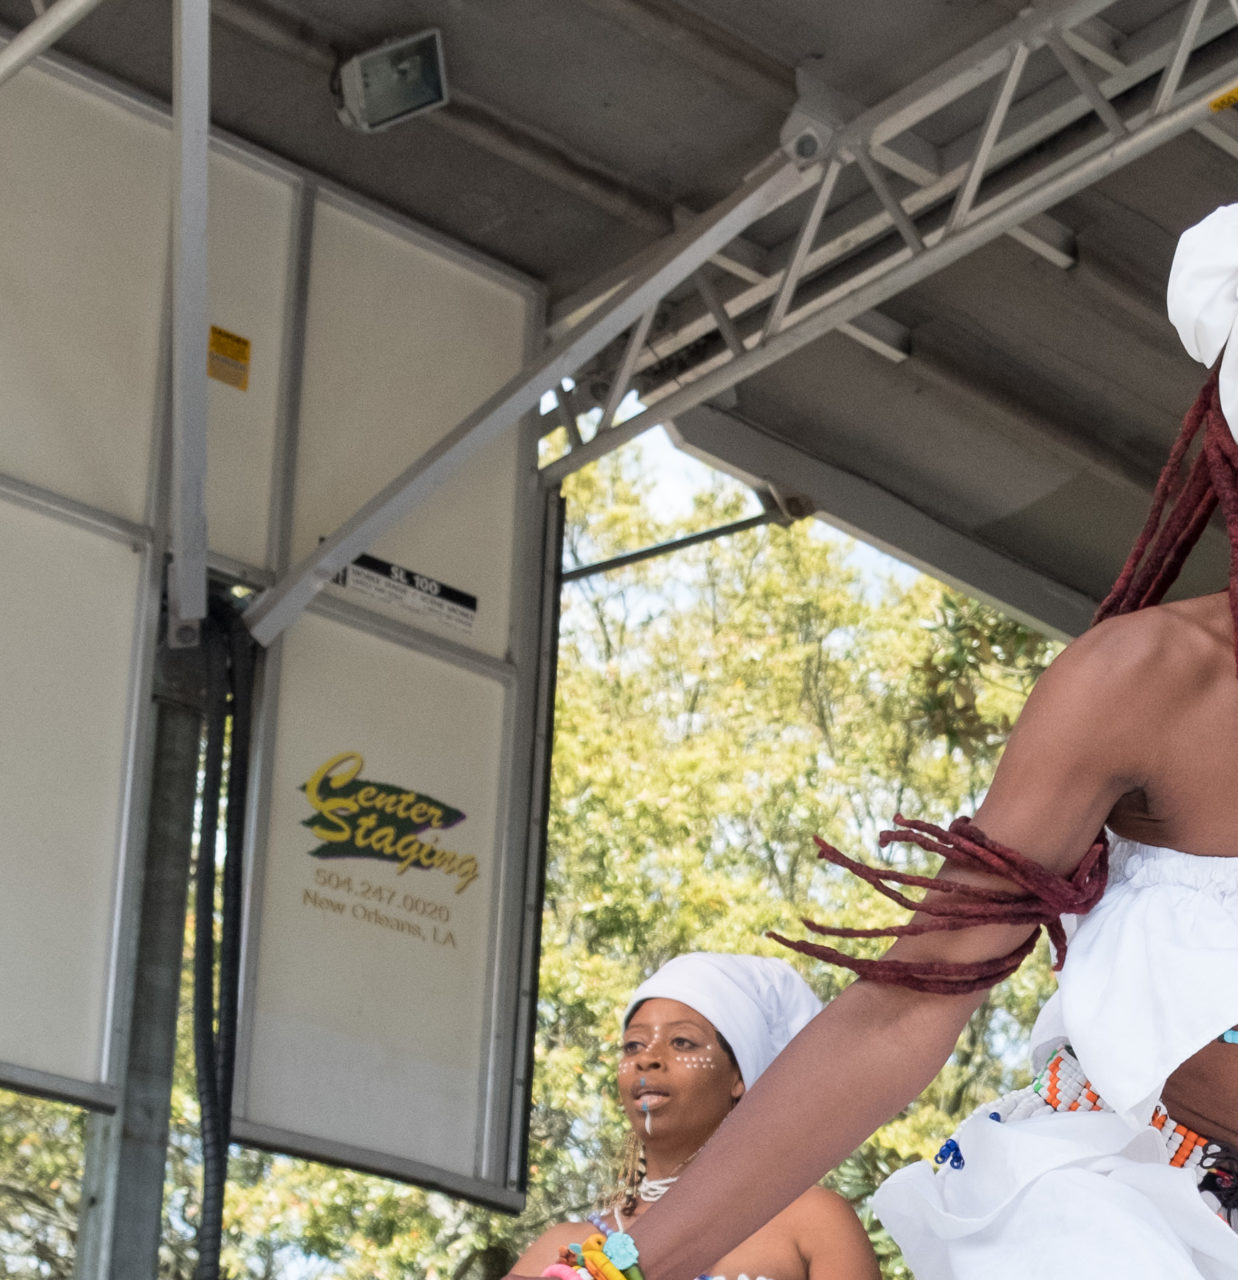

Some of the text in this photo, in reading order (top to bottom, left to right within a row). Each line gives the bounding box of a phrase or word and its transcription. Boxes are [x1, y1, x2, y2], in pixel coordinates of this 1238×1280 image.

[390, 564, 440, 596] SL 100
[305, 751, 444, 829] Center
[312, 796, 480, 895] Staging
[302, 887, 458, 950] New Orleans, LA
[313, 867, 450, 923] 504.247.0020
